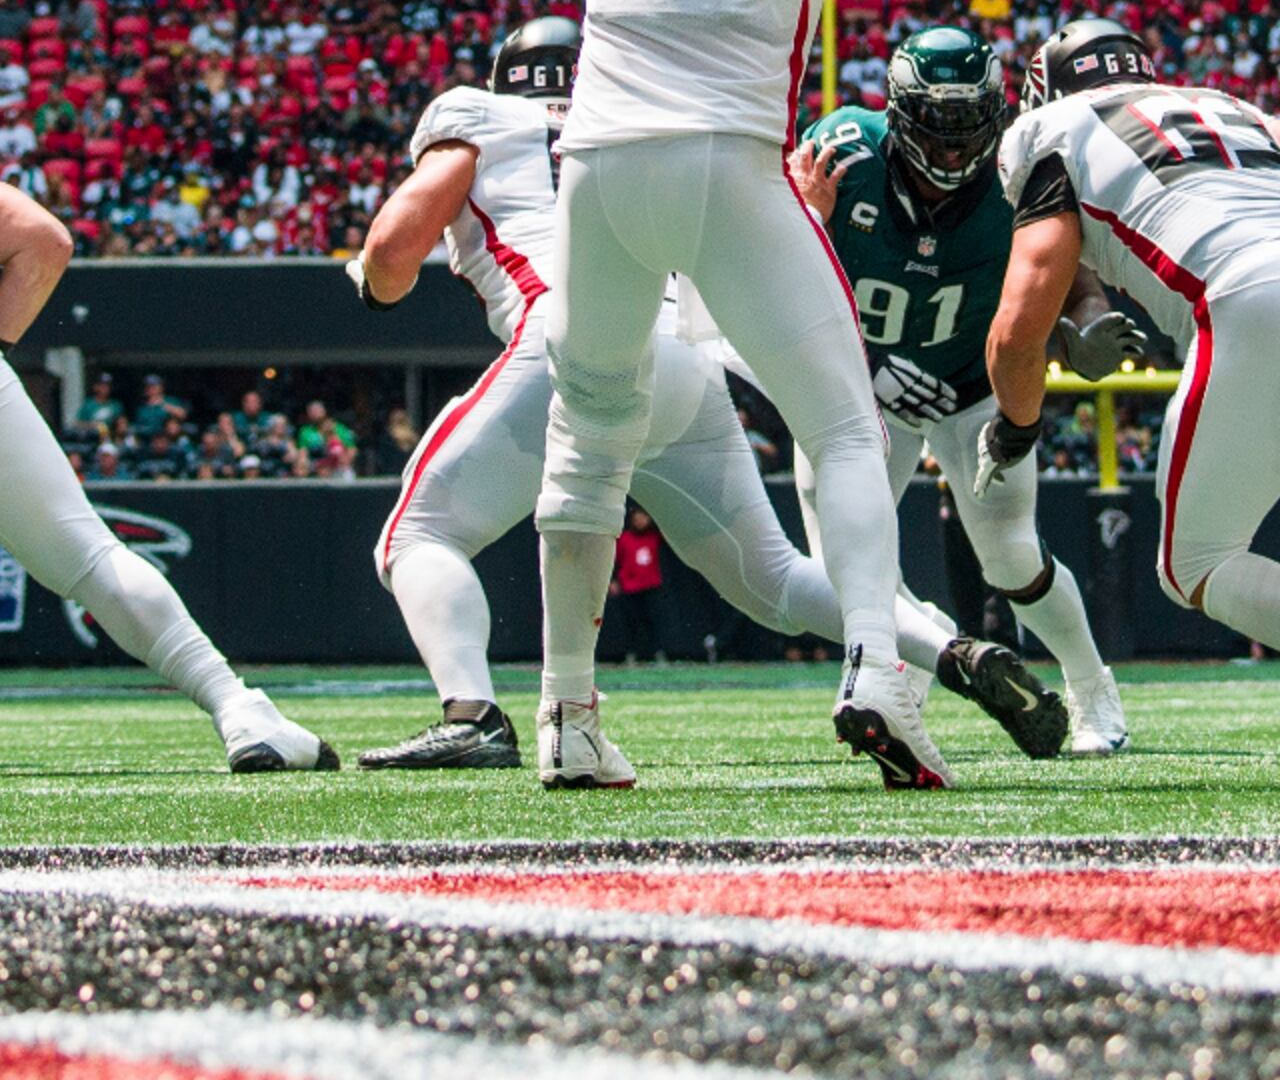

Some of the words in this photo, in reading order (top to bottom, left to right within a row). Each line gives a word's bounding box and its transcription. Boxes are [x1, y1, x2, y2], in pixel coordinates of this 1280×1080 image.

[1103, 53, 1139, 75] 63
[533, 66, 565, 87] 61
[851, 201, 880, 227] C
[855, 277, 965, 347] 91
